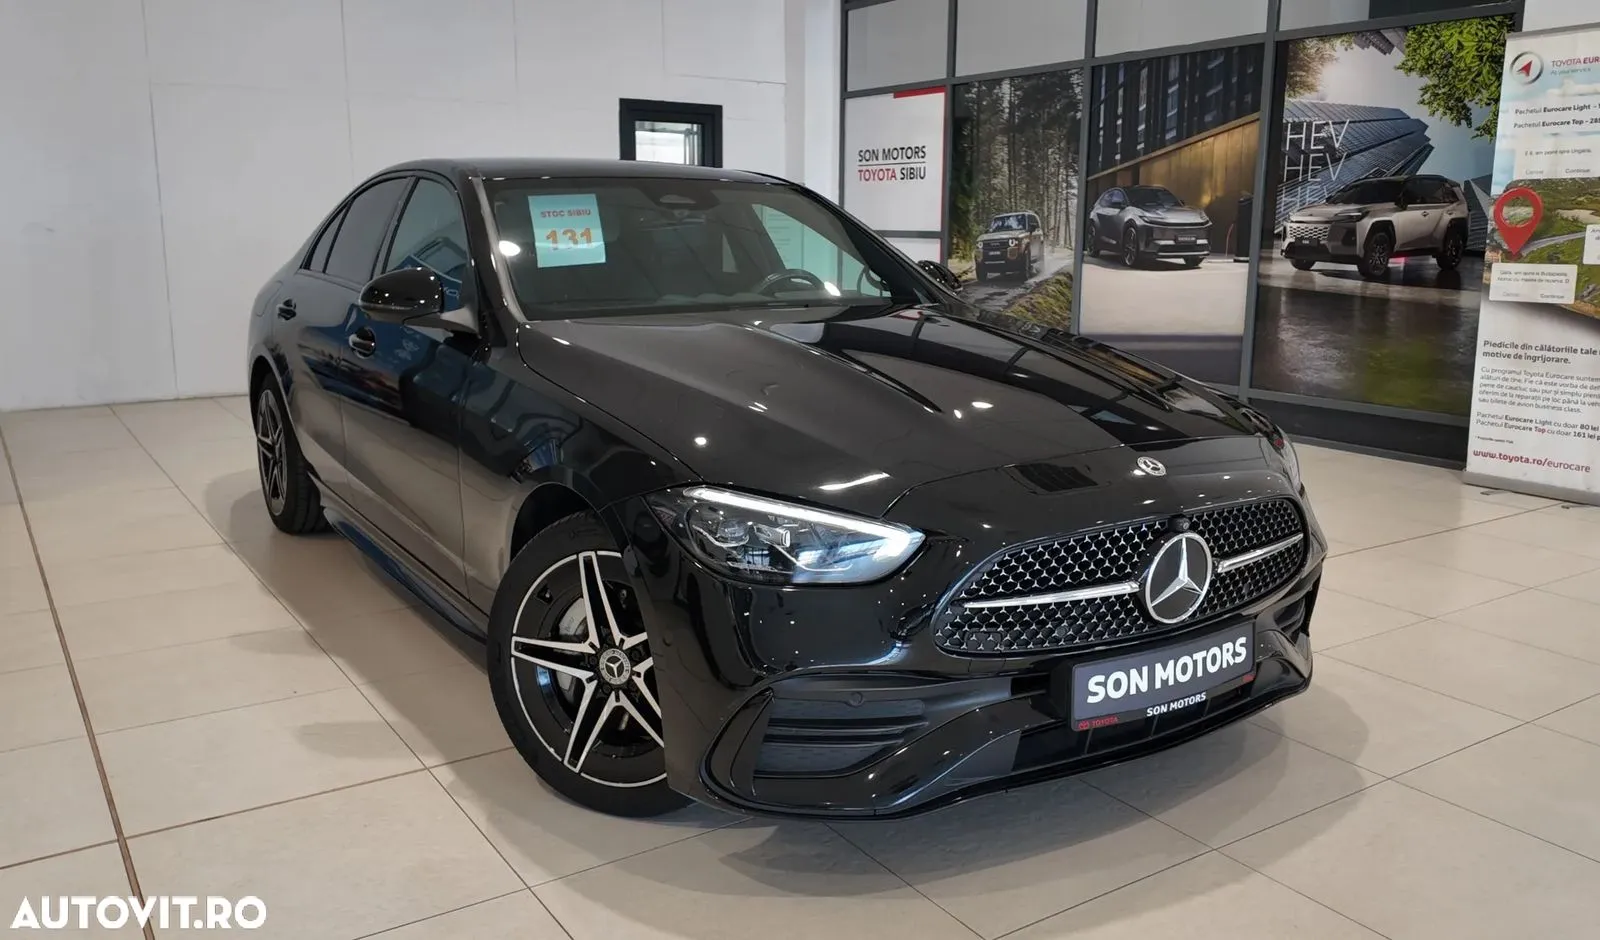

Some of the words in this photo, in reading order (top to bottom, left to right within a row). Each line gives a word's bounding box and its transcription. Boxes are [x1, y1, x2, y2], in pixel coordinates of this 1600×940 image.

[1552, 58, 1582, 68] TOYOTA
[1543, 105, 1572, 113] Eurocare
[1573, 104, 1590, 112] Light
[1542, 118, 1571, 127] Eurocare
[1572, 118, 1584, 126] Top
[1286, 120, 1350, 151] HEV
[858, 148, 879, 162] SON
[882, 145, 926, 160] MOTORS
[858, 168, 897, 181] TOYOTA
[900, 166, 926, 180] SIBIU
[1284, 152, 1348, 182] HEV
[541, 210, 566, 218] STOC
[567, 208, 592, 217] SIBIU
[546, 227, 592, 250] 131
[1482, 351, 1512, 360] motive
[1483, 340, 1518, 350] Piedicile
[1520, 342, 1532, 350] din
[1580, 348, 1598, 356] tale
[1524, 370, 1544, 378] Toyota
[1545, 372, 1574, 380] Eurocare
[1476, 411, 1504, 420] Pachetul
[1504, 414, 1534, 424] Eurocare
[1535, 418, 1552, 427] Light
[1504, 422, 1532, 432] Eurocare
[1534, 426, 1547, 434] Top
[1473, 449, 1591, 472] www.toyota.ro/eurocare
[1086, 665, 1148, 704] SON
[1154, 636, 1247, 690] MOTORS
[1146, 702, 1168, 717] SON
[1170, 692, 1207, 712] MOTORS
[1091, 716, 1120, 728] TOYOTA
